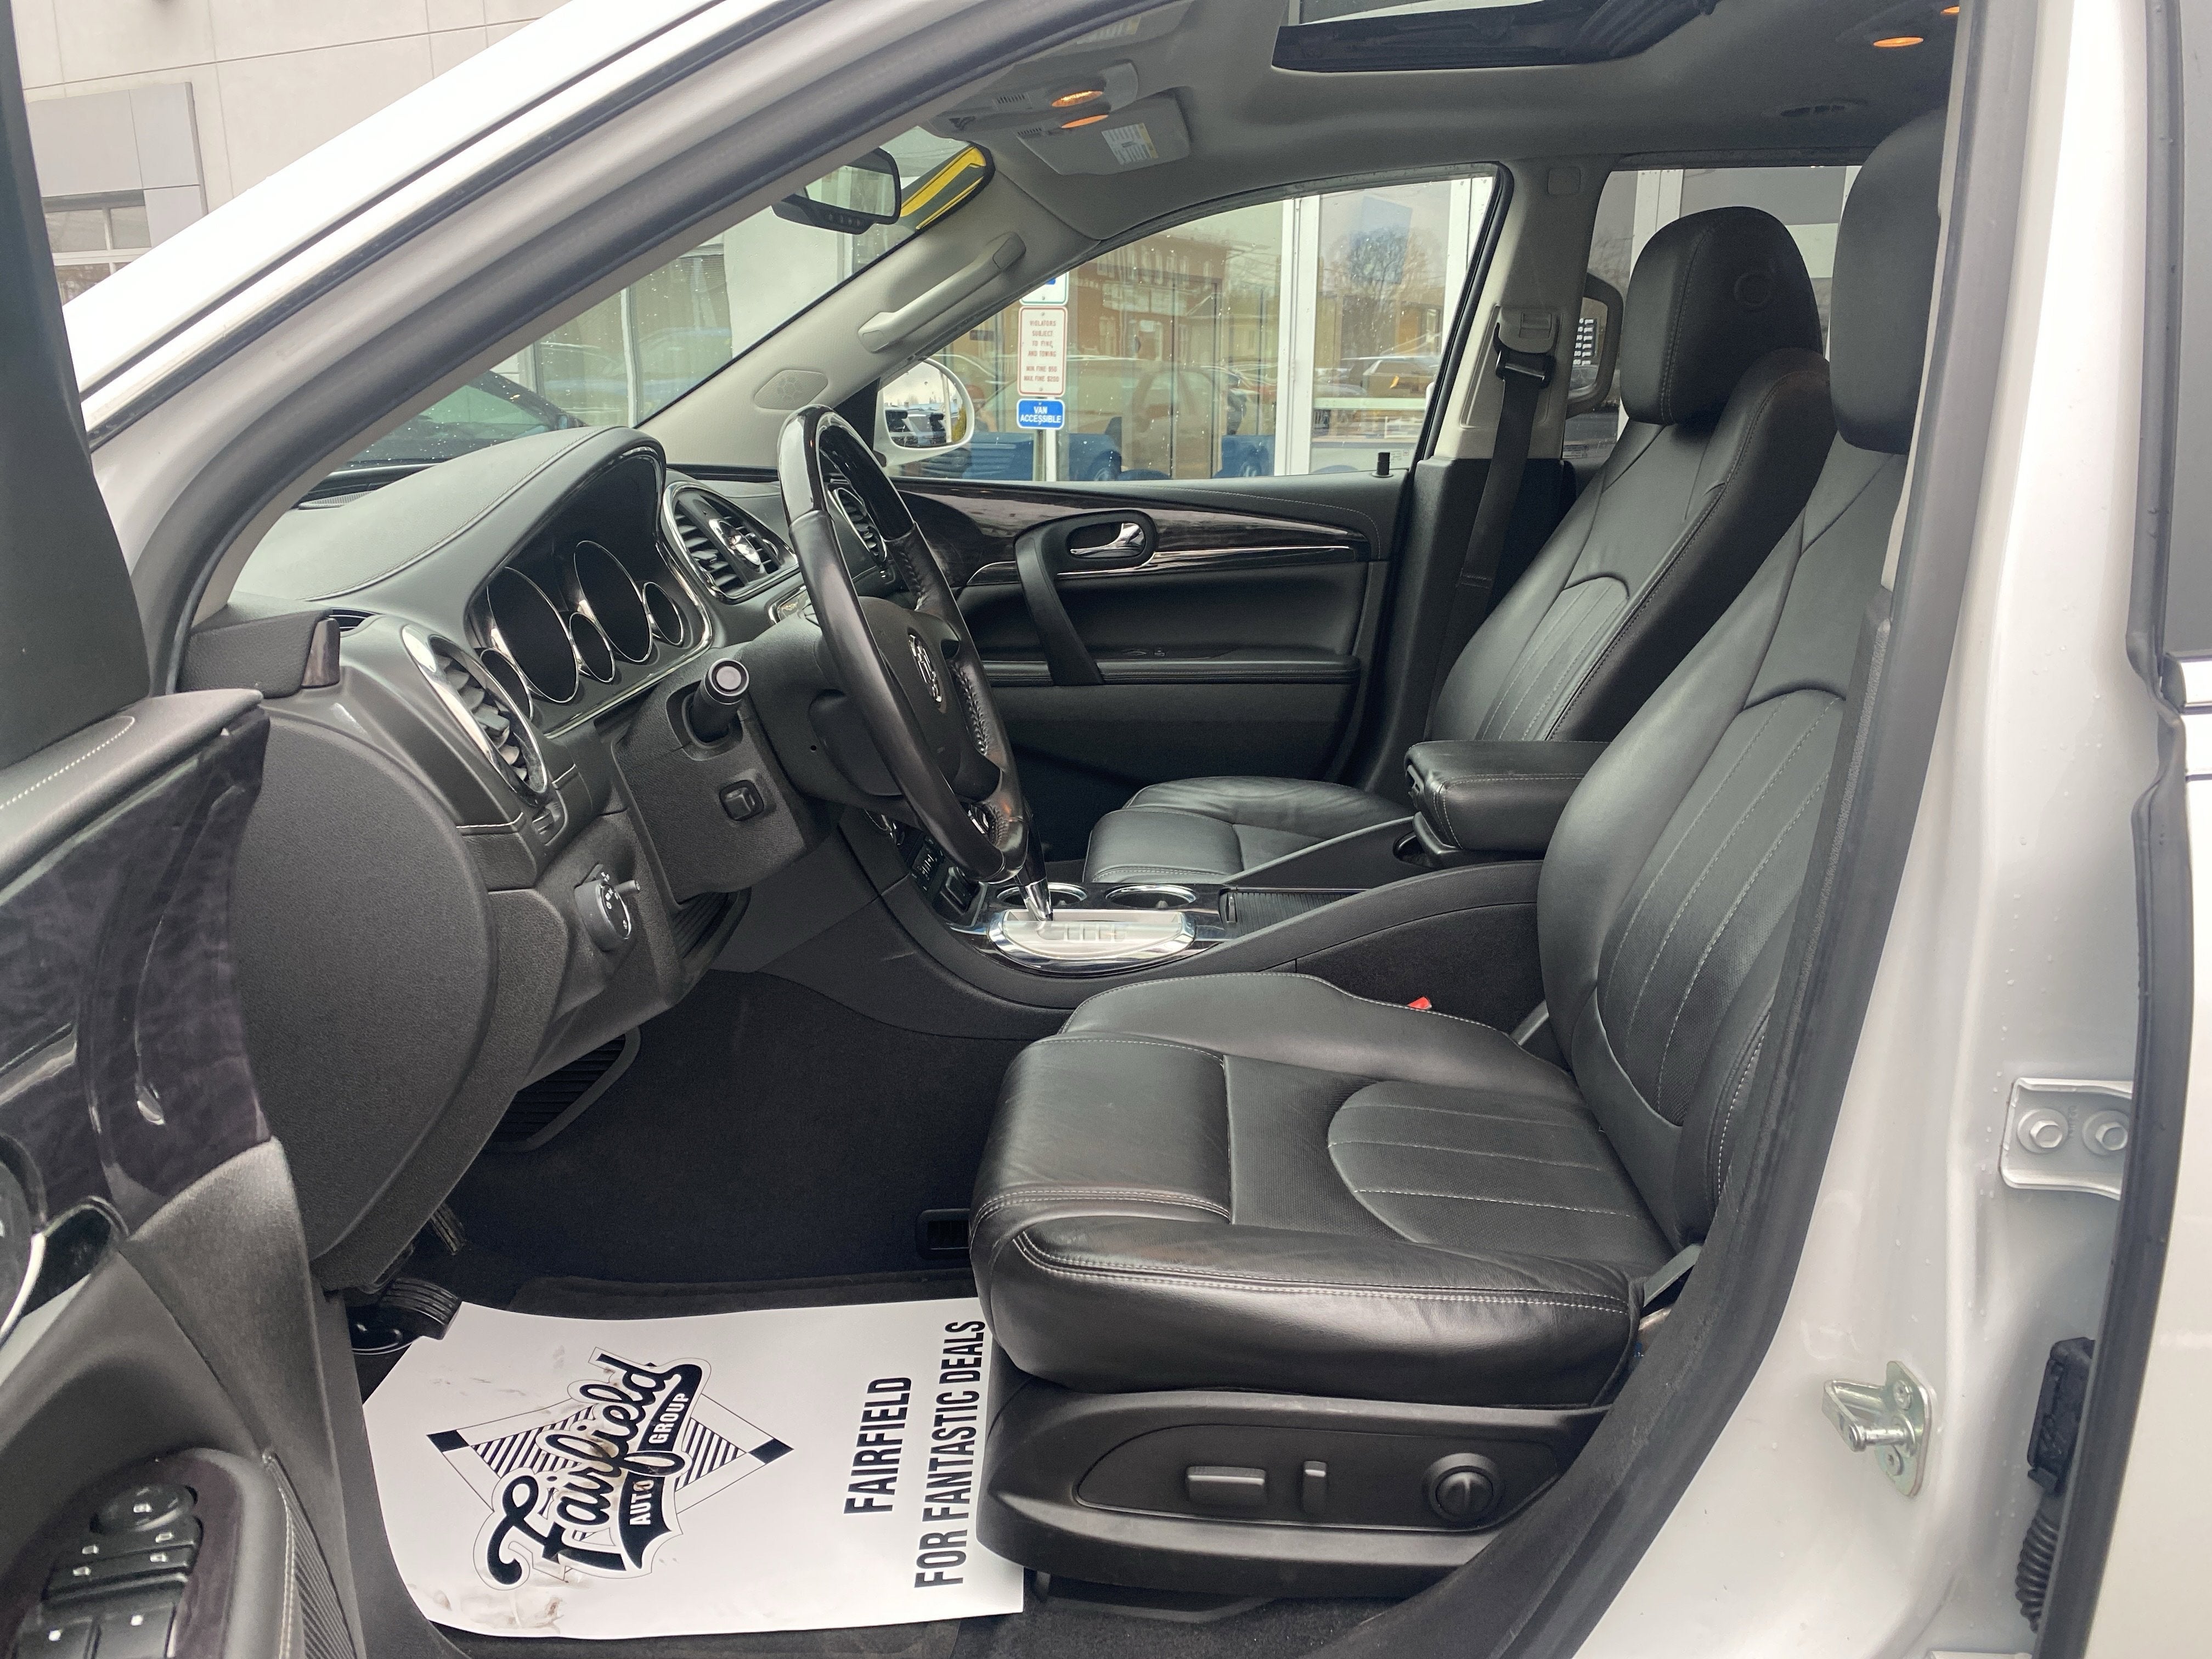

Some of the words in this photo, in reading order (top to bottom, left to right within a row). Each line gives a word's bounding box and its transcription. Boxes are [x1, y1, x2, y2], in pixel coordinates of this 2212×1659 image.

[1020, 414, 1062, 423] ACCESSIBLE
[1034, 406, 1048, 414] VAN
[939, 1321, 986, 1385] DEALS
[629, 1480, 654, 1526] AUTO
[648, 1392, 690, 1445] GROUP
[843, 1377, 912, 1514] FAIRFIELD
[922, 1390, 980, 1522] FANTASTIC
[914, 1529, 968, 1588] FOR
